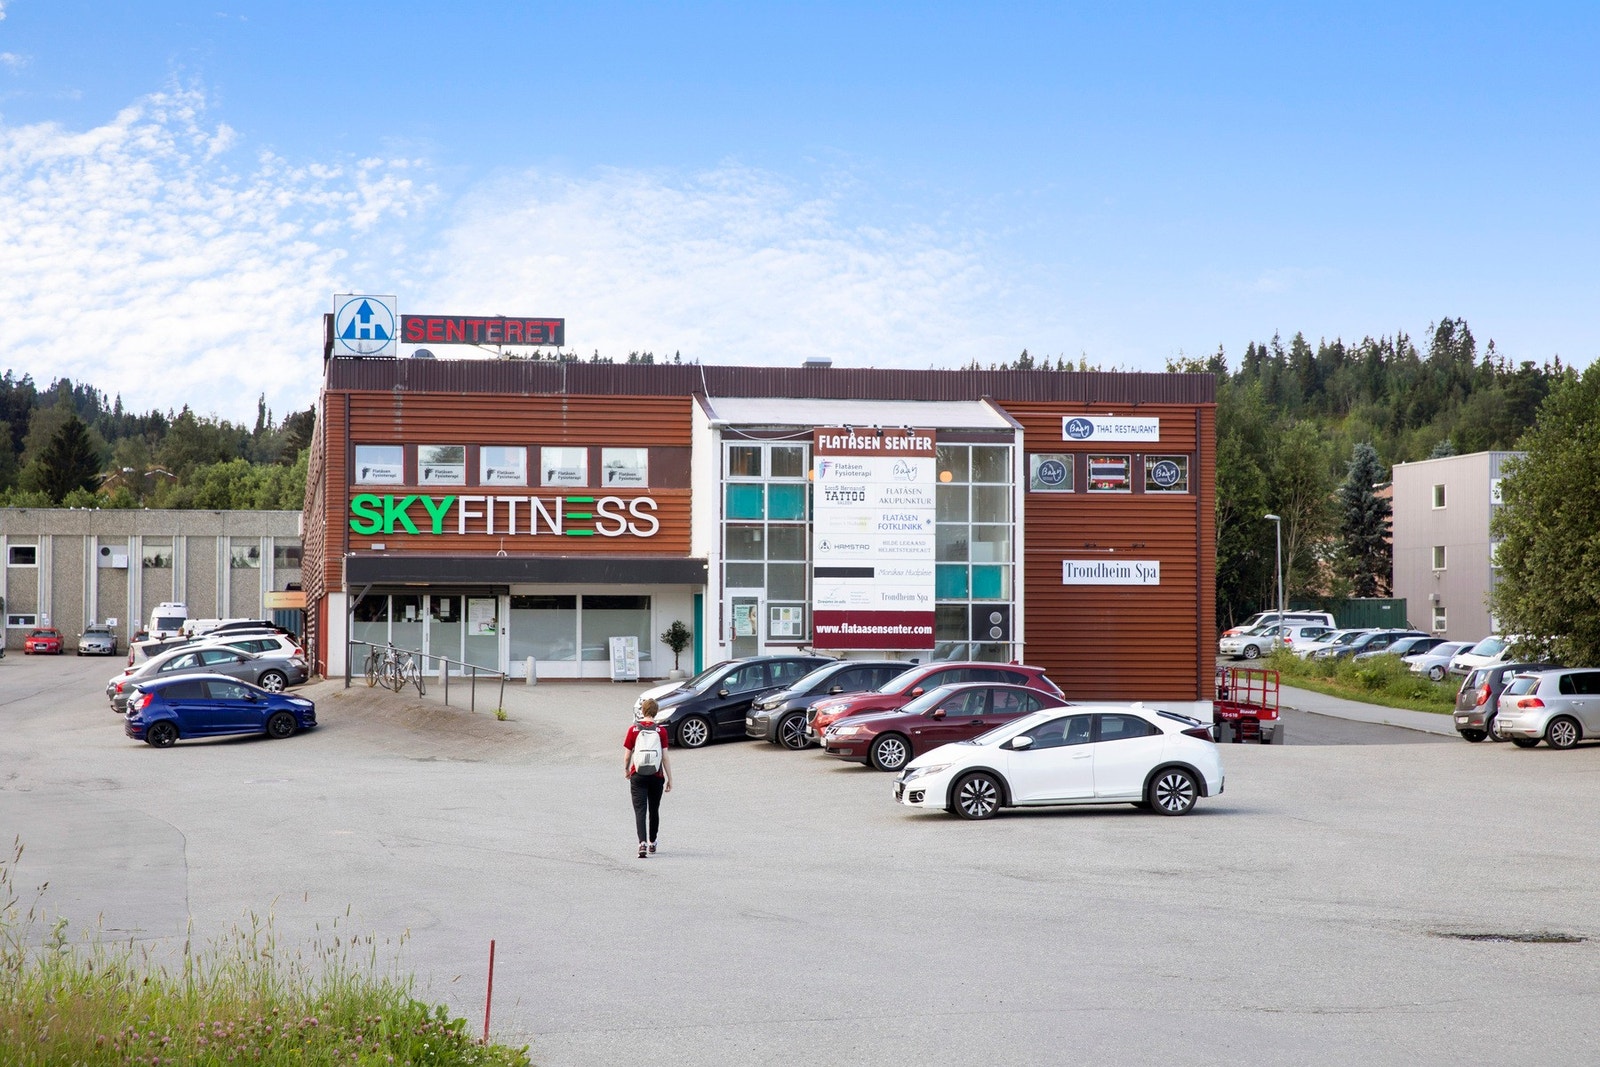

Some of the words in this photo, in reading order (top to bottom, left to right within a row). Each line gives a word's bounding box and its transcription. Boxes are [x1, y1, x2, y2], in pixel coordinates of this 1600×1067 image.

[406, 317, 561, 343] SENTERET
[1097, 425, 1112, 434] THAI
[1114, 425, 1157, 434] RESTAURANT
[819, 433, 881, 450] FLATÅSEN
[885, 436, 933, 450] SENTER
[824, 491, 865, 501] TATTOO
[349, 494, 660, 537] SKYFITNESS
[882, 513, 918, 522] FLATÅSEN
[1065, 562, 1131, 578] Trondheim
[1135, 562, 1157, 582] Spa
[881, 592, 915, 601] Trondheim
[917, 592, 928, 602] Spa
[816, 622, 932, 635] www.flataasensenter.com
